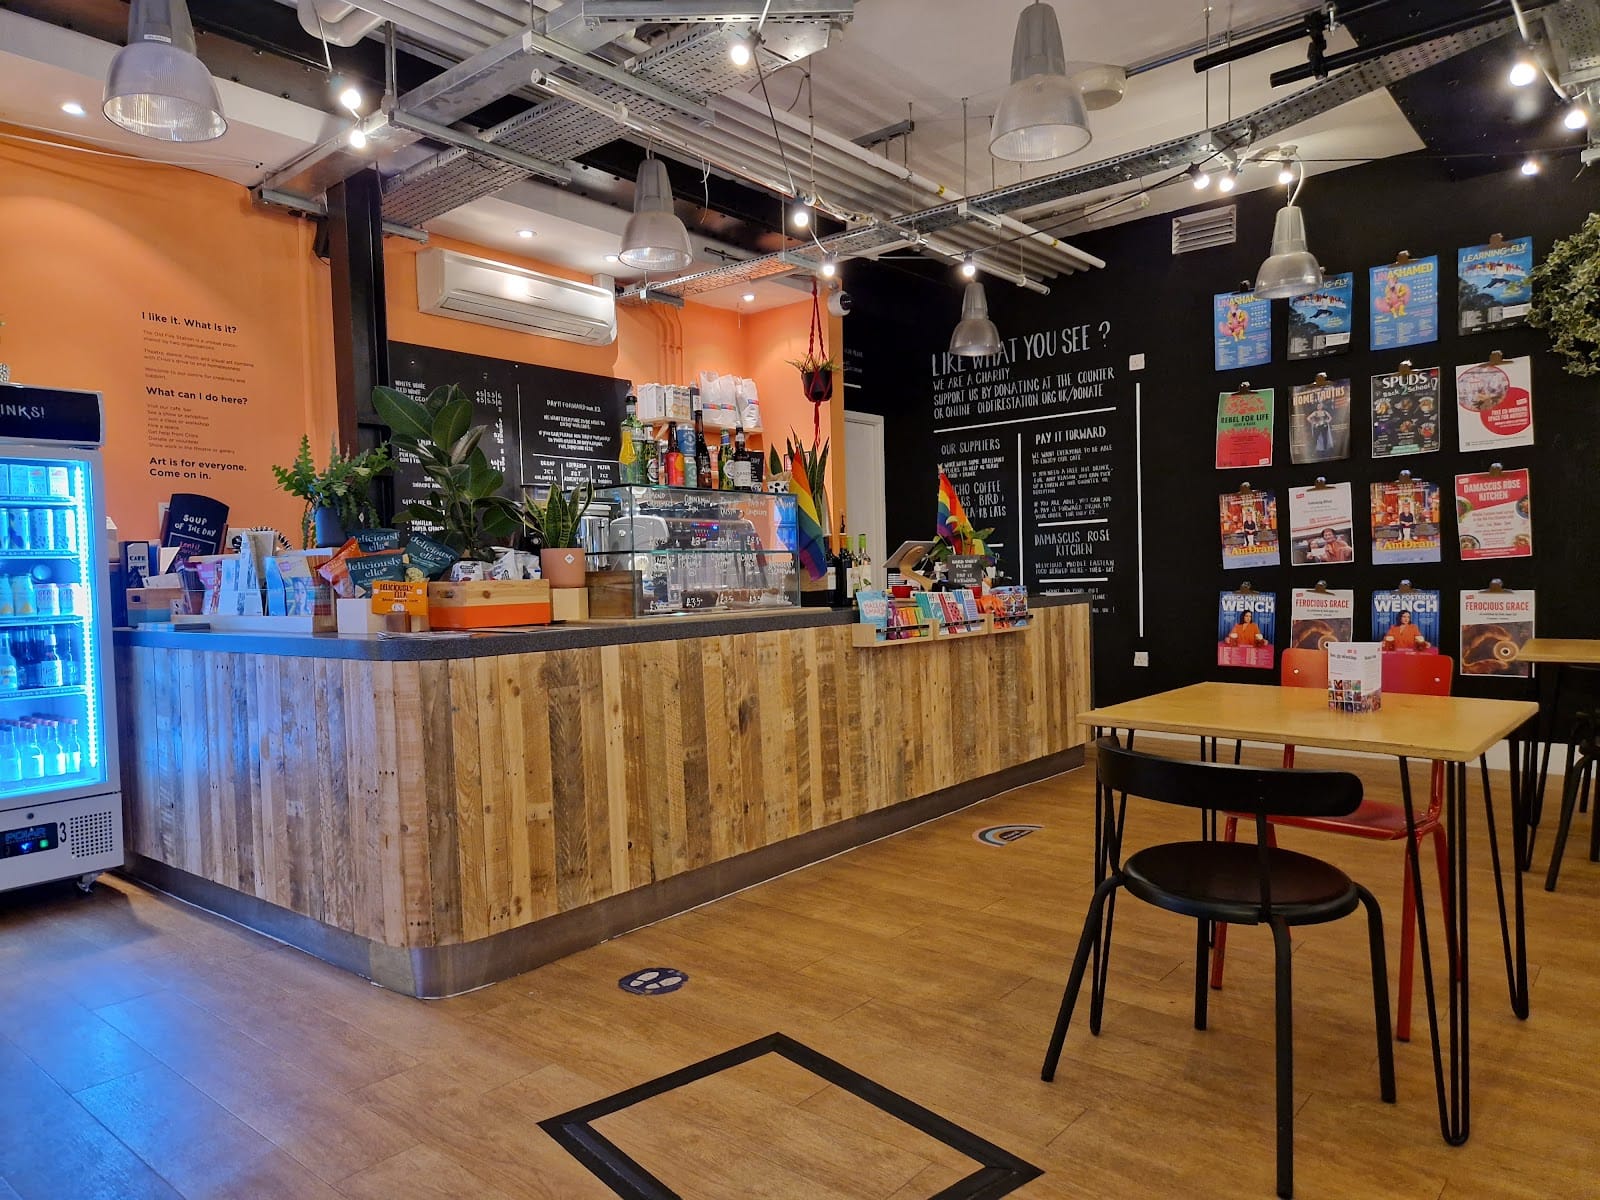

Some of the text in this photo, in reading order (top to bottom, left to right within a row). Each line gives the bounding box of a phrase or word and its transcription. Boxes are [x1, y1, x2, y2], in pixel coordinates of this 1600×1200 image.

[1462, 243, 1528, 263] LEARNING FLY
[1374, 263, 1433, 282] UNASHAMED
[1217, 294, 1264, 308] UNASHAM
[141, 311, 237, 334] I like it. What is it?
[932, 350, 966, 377] LIKE
[1023, 331, 1057, 361] YOU
[1062, 324, 1090, 354] SEE
[1098, 320, 1111, 348] ?
[933, 367, 1011, 391] WE ARE A CHARITY
[1382, 373, 1428, 389] SPUDS
[413, 382, 426, 390] WINE
[933, 366, 1115, 406] SUPPORT US BY DONATING AT THE COUNTER
[1383, 384, 1430, 397] Back 2 School
[146, 386, 248, 405] What can I do here?
[1293, 386, 1345, 405] HOME TRUTHS
[0, 403, 45, 419] INKS!
[933, 408, 944, 419] OR
[946, 404, 970, 417] ONLINE
[1256, 413, 1269, 421] LIFE
[1035, 426, 1107, 445] PAY IT FORWARD
[941, 438, 1001, 456] OUR SUPPLIERS
[150, 457, 247, 472] Art is for everyone.
[149, 468, 211, 480] Come on in.
[973, 480, 1000, 494] COFFEE
[1464, 479, 1521, 494] DAMASCUS ROSE
[979, 494, 999, 506] BIRD
[1479, 490, 1508, 501] KITCHEN
[183, 514, 208, 525] SOUP
[188, 524, 201, 534] THE
[201, 528, 217, 537] DAY
[353, 531, 400, 542] eliciousl
[1035, 529, 1111, 547] DAMASCUS ROSE
[1384, 539, 1437, 550] AmDram
[368, 541, 385, 552] ella
[1056, 543, 1093, 556] KITCHEN
[1231, 545, 1277, 556] AmDram
[365, 570, 383, 578] ella
[379, 584, 414, 592] DELICIOUSLY
[1222, 600, 1275, 613] WENCH
[1295, 599, 1349, 608] FEROCIOUS GRACE
[1374, 600, 1438, 612] WENCH
[1465, 601, 1529, 611] FEROCIOUS GRACE
[60, 822, 66, 842] 3
